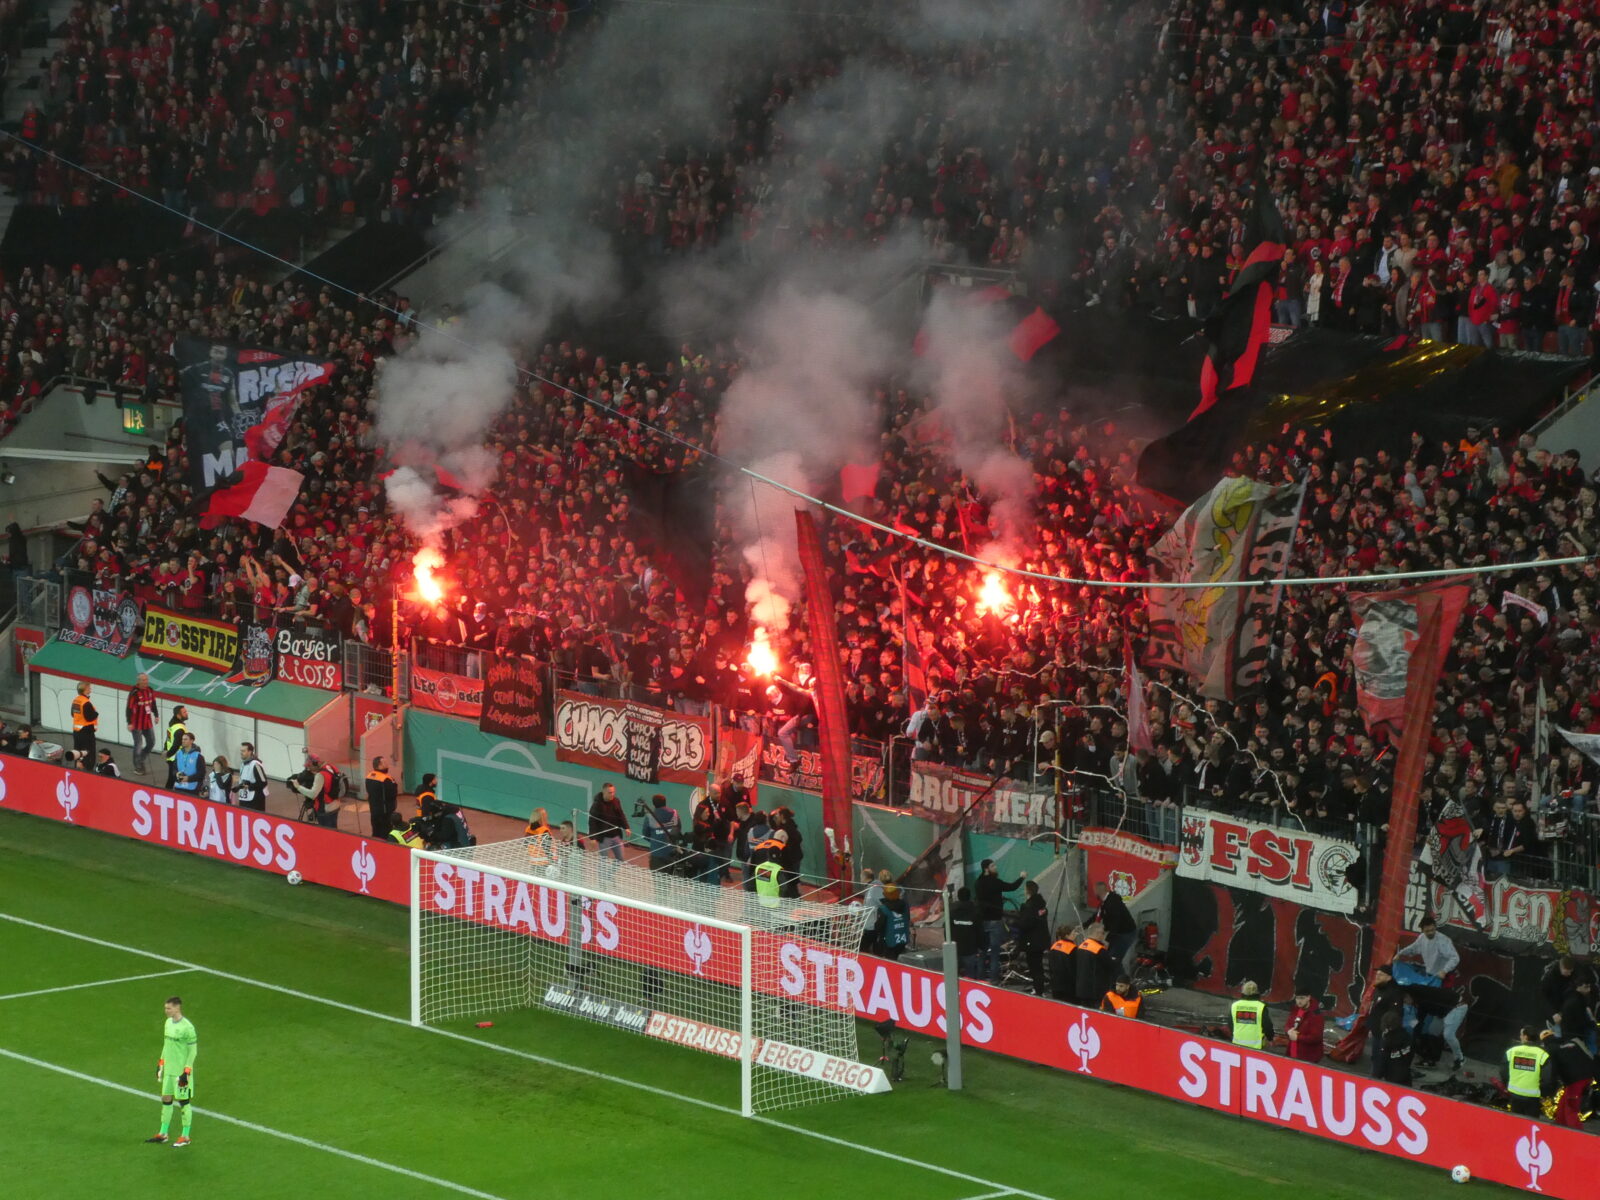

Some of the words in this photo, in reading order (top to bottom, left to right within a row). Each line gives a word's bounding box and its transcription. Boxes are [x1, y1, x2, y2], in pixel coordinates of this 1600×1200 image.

[239, 361, 325, 404] RHEIN
[278, 629, 337, 661] Bayer
[556, 701, 629, 761] CHAOS
[660, 721, 705, 770] 513
[629, 720, 656, 738] CHAOS
[131, 789, 297, 872] STRAUSS
[1209, 818, 1315, 890] FSI
[894, 934, 907, 944] 24
[545, 986, 573, 1006] bwin
[580, 996, 609, 1018] bwin
[615, 1006, 646, 1028] bwin
[779, 942, 995, 1044] STRAUSS
[662, 1019, 742, 1057] STRAUSS
[763, 1044, 814, 1073] ERGO
[821, 1059, 873, 1088] ERGO
[1178, 1041, 1429, 1155] STRAUSS
